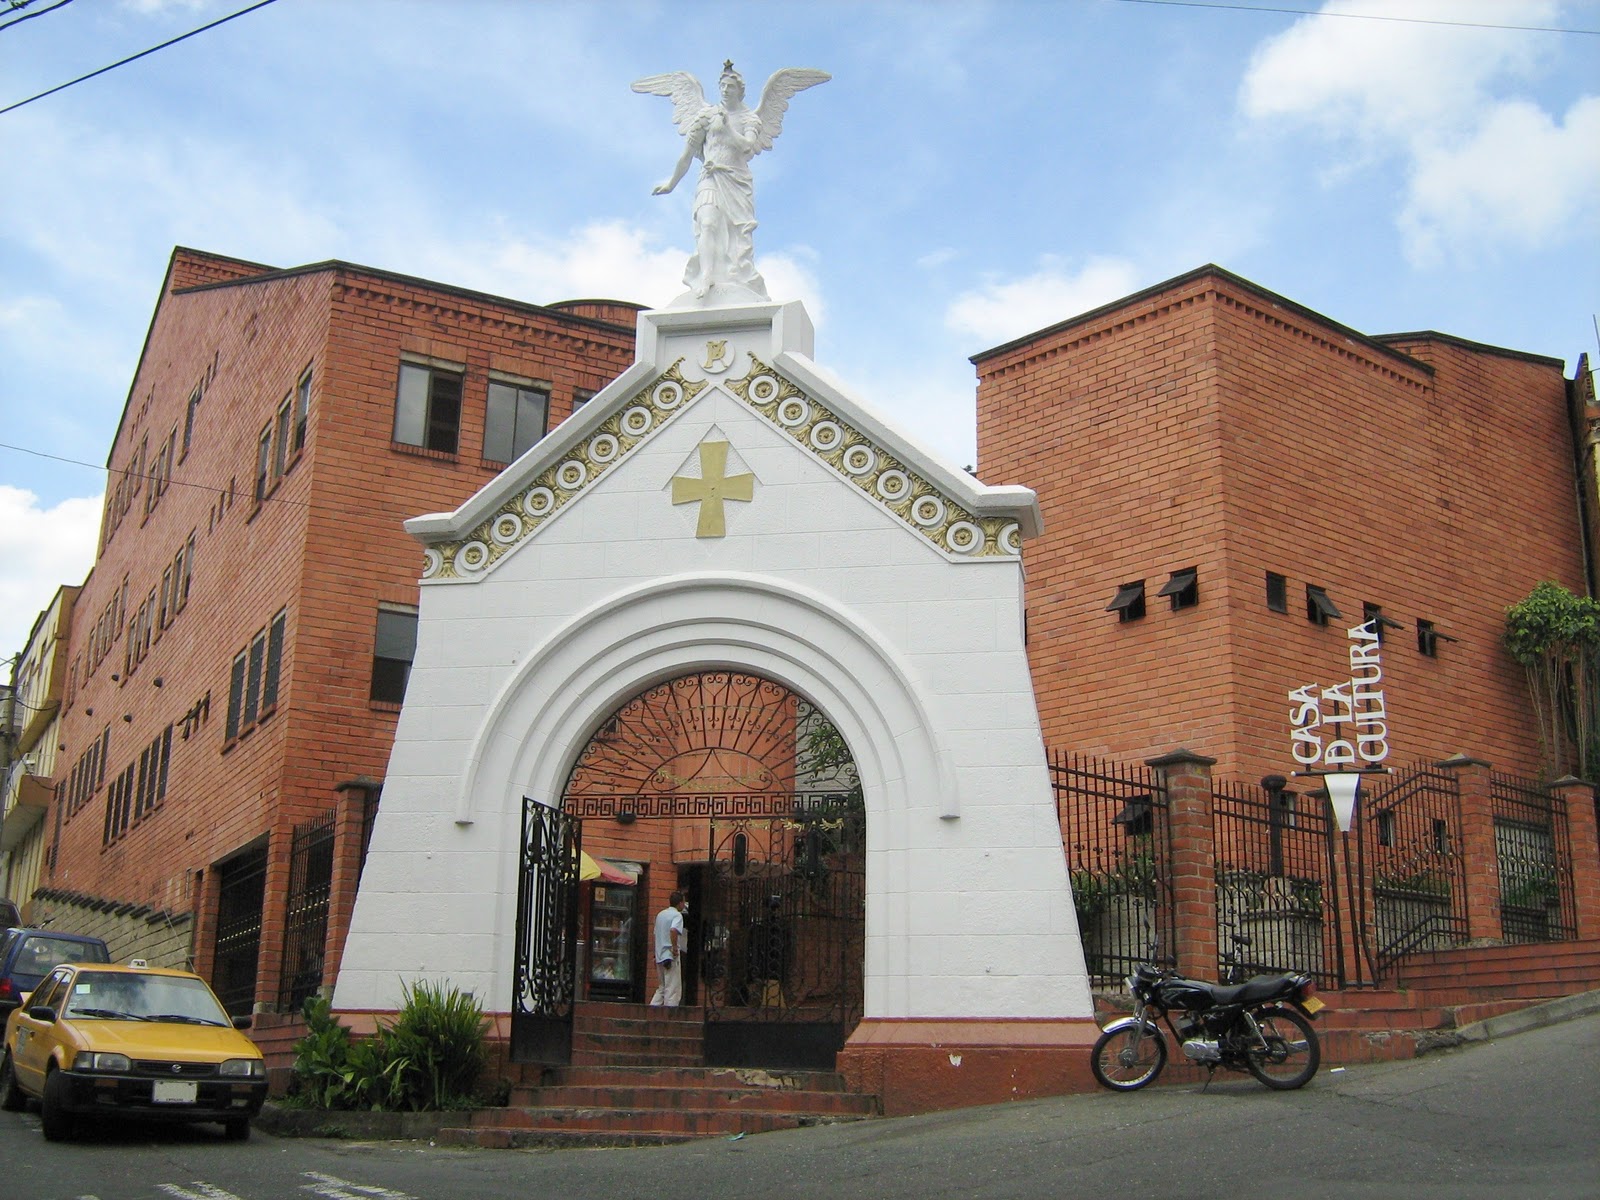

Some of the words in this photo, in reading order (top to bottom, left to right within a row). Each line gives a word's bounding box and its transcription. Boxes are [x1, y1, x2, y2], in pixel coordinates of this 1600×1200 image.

[1288, 683, 1321, 764] CASA
[1322, 681, 1353, 725] LA
[1348, 618, 1389, 762] CULTURA
